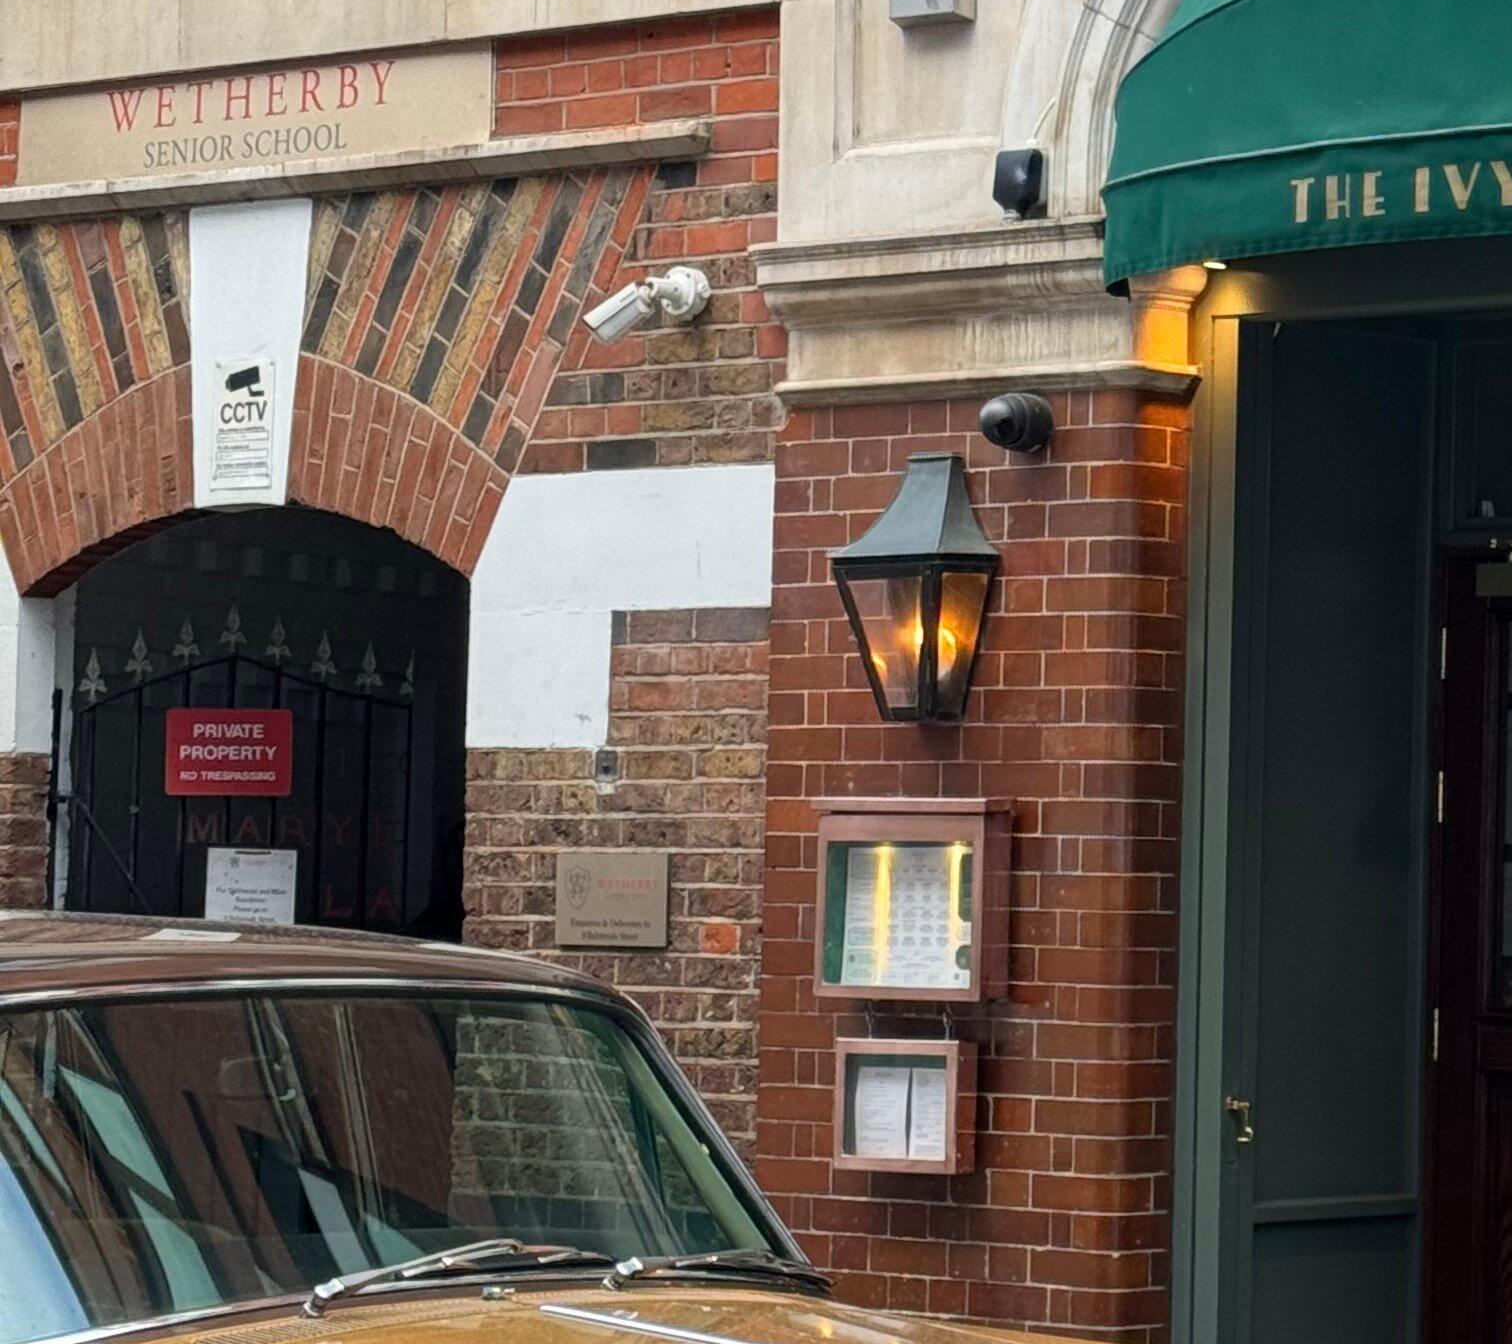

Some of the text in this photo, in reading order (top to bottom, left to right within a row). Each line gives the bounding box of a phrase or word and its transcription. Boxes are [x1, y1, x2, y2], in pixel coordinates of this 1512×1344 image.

[105, 60, 396, 133] WETHERBY
[143, 122, 348, 169] SENIOR SCHOOL
[1290, 170, 1386, 224] THE
[220, 400, 267, 424] CCTV
[193, 723, 265, 738] PRIVATE
[180, 744, 277, 761] PROPERTY
[180, 771, 276, 781] NO TRESPASSING
